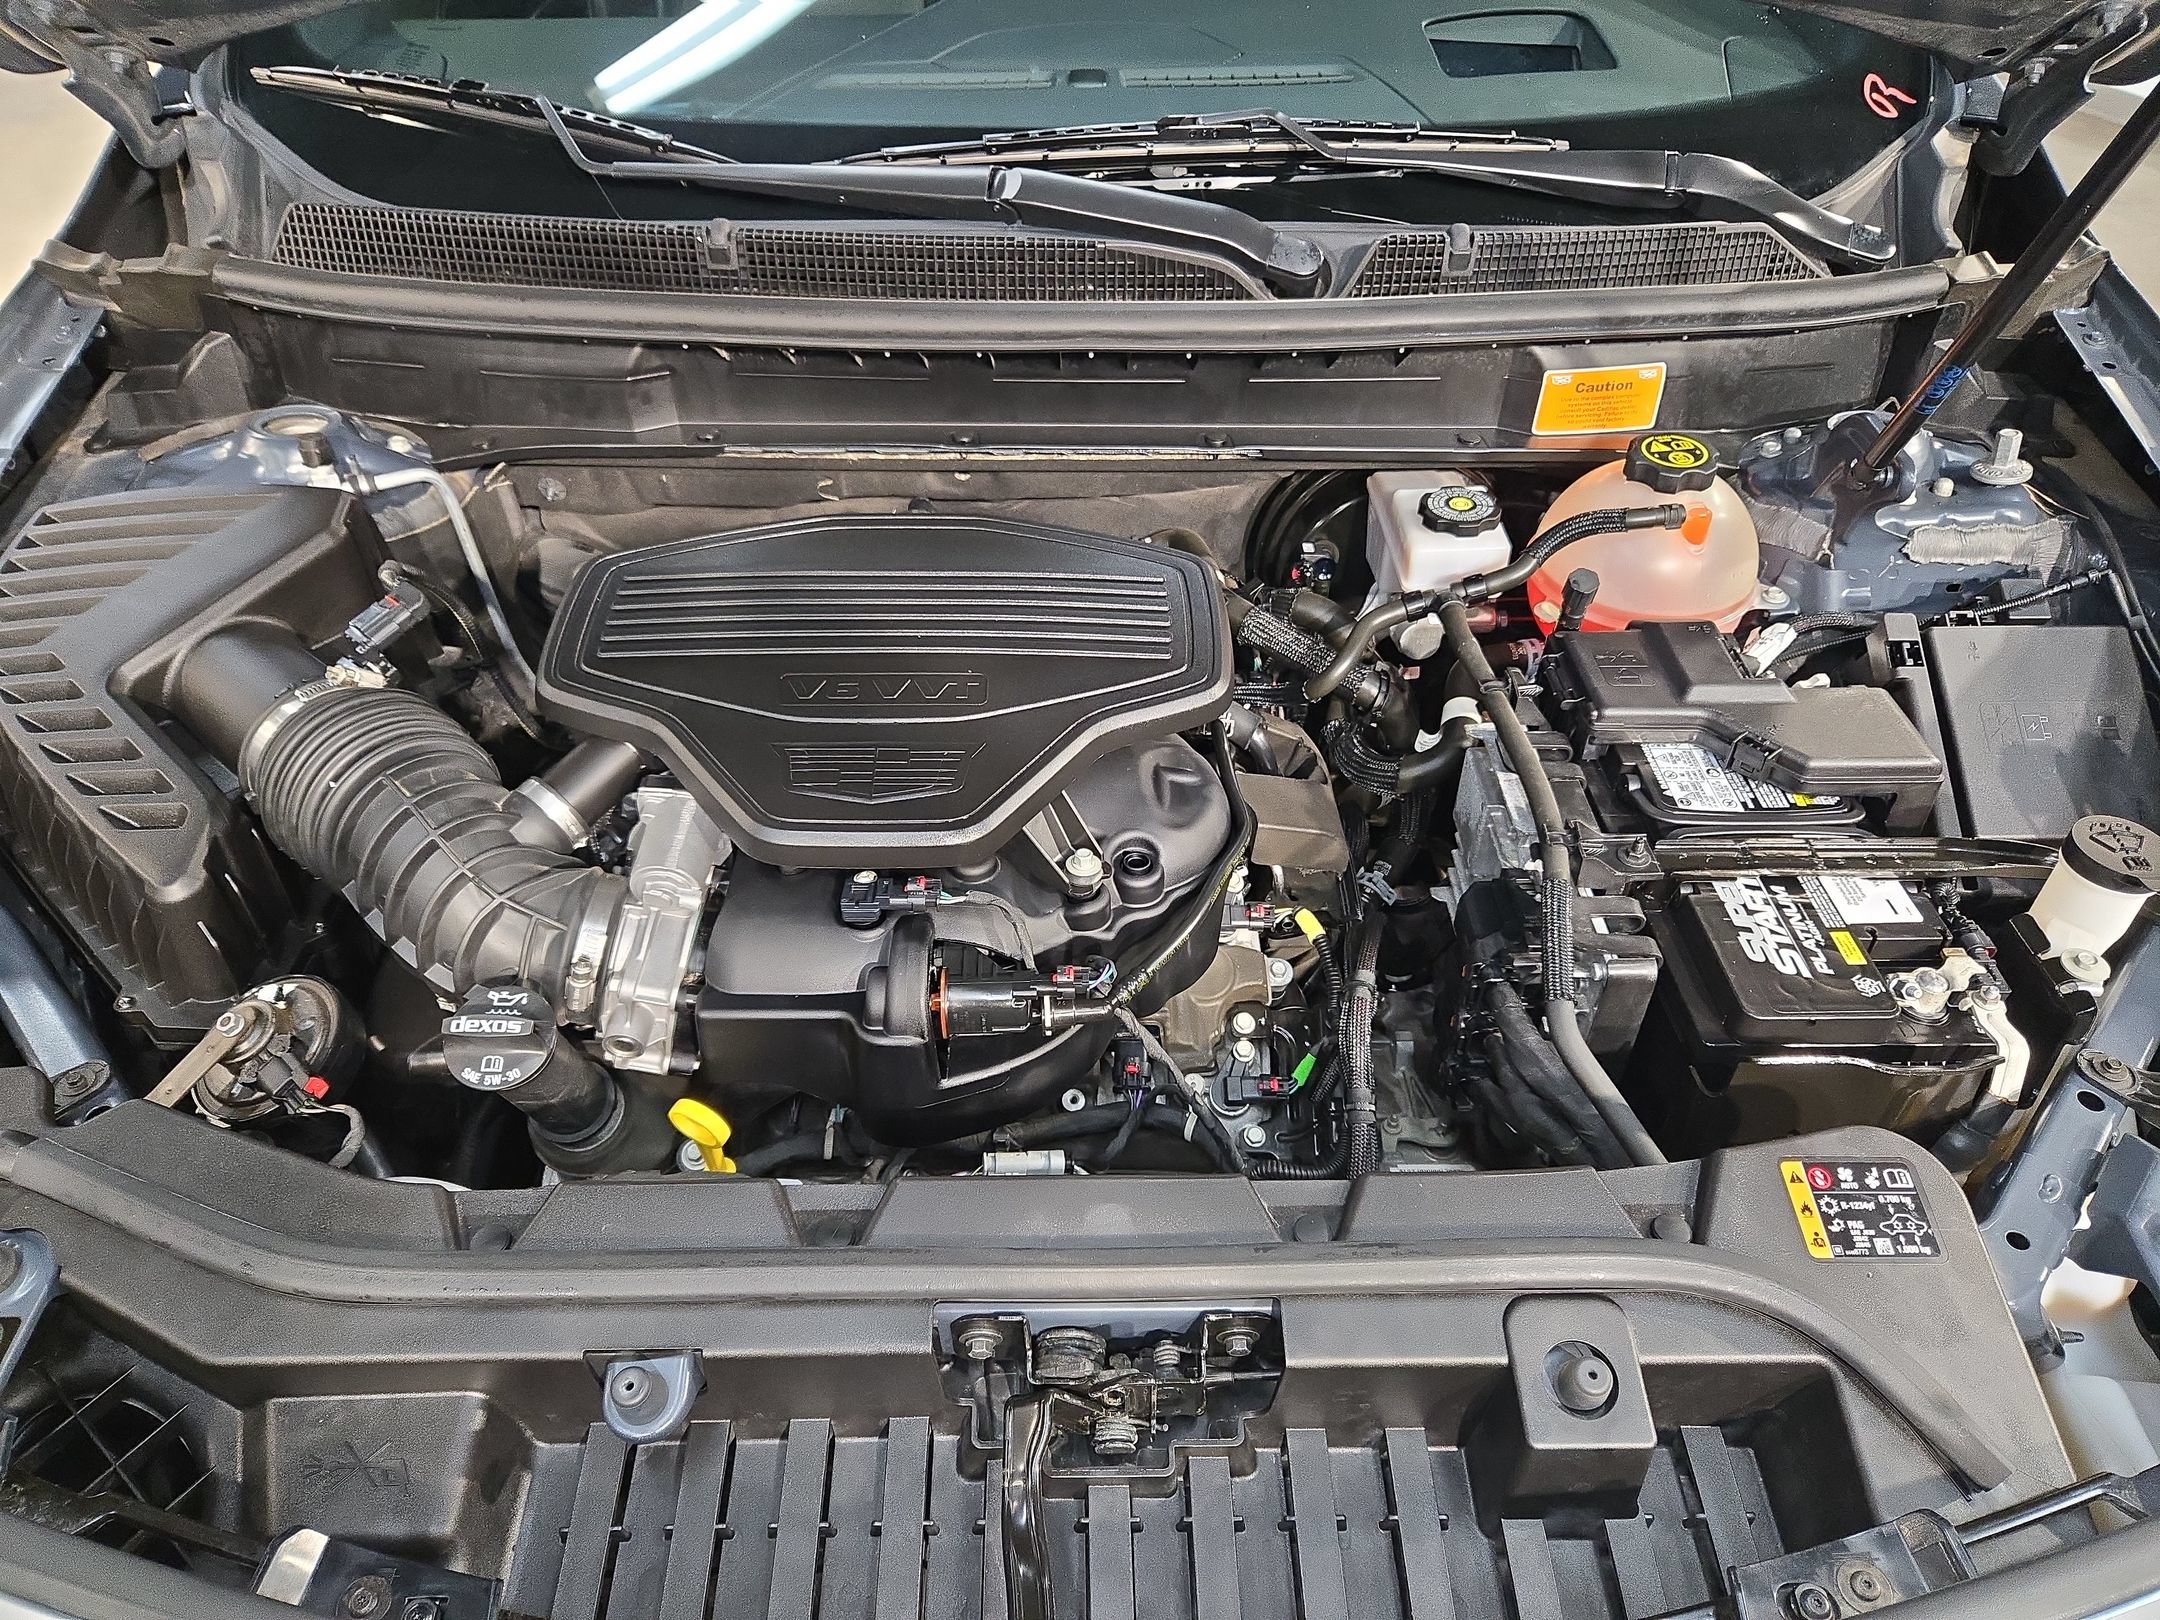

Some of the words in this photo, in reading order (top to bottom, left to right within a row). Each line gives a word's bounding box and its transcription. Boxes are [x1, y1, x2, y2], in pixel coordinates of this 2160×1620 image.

[1576, 381, 1633, 393] Caution
[1712, 881, 1774, 963] SUPE
[1769, 885, 1836, 975] PLATINUM
[450, 1015, 525, 1034] dexos
[461, 1067, 482, 1084] SAE
[483, 1068, 522, 1086] 5W-30
[1840, 1201, 1876, 1211] R-1234yf
[1846, 1220, 1865, 1230] PAG
